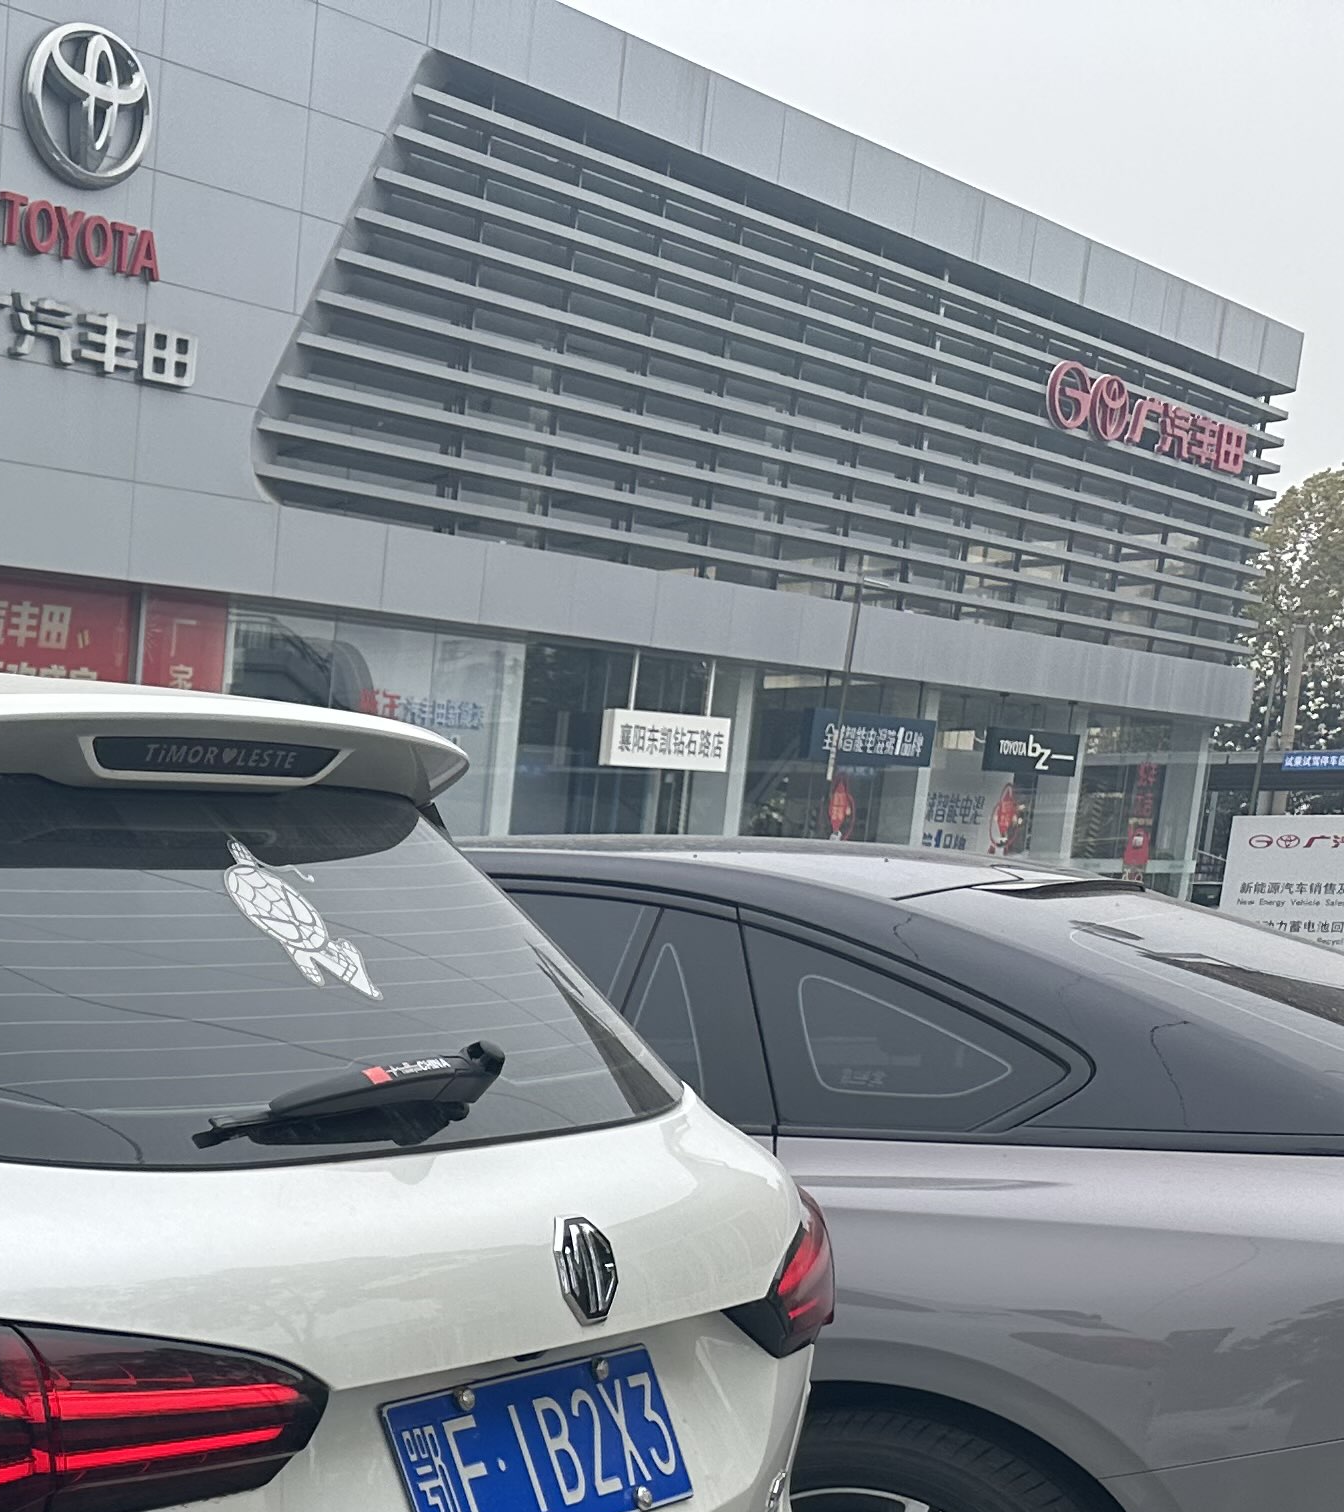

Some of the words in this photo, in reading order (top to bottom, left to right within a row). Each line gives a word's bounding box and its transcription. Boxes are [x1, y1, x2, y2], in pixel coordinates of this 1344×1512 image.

[1123, 394, 1247, 475] 广汽丰田
[999, 739, 1026, 756] TOYOTA
[236, 750, 298, 770] LESTE
